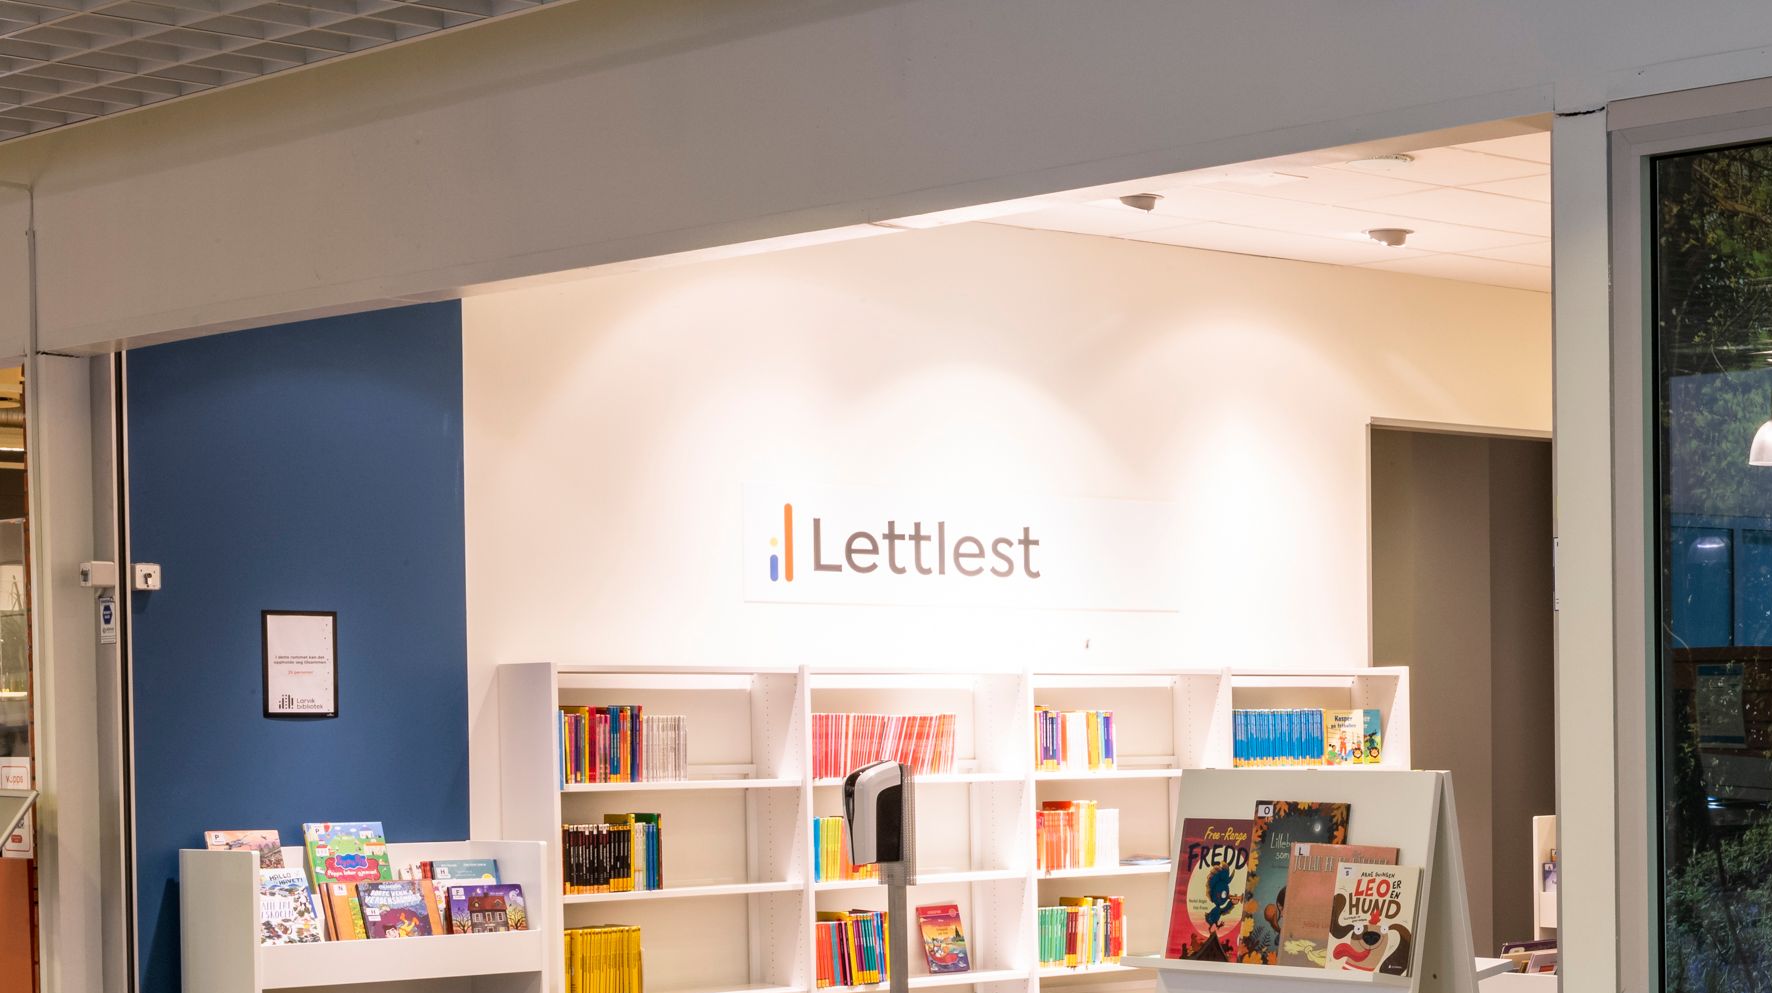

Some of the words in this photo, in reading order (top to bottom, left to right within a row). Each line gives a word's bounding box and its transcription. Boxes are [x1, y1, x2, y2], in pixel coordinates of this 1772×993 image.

[812, 517, 1041, 579] Lettlest
[1204, 826, 1248, 846] Free-Range
[1354, 878, 1391, 898] LEO
[1392, 880, 1402, 889] ER
[1390, 891, 1401, 900] EN
[1348, 892, 1401, 919] HUND
